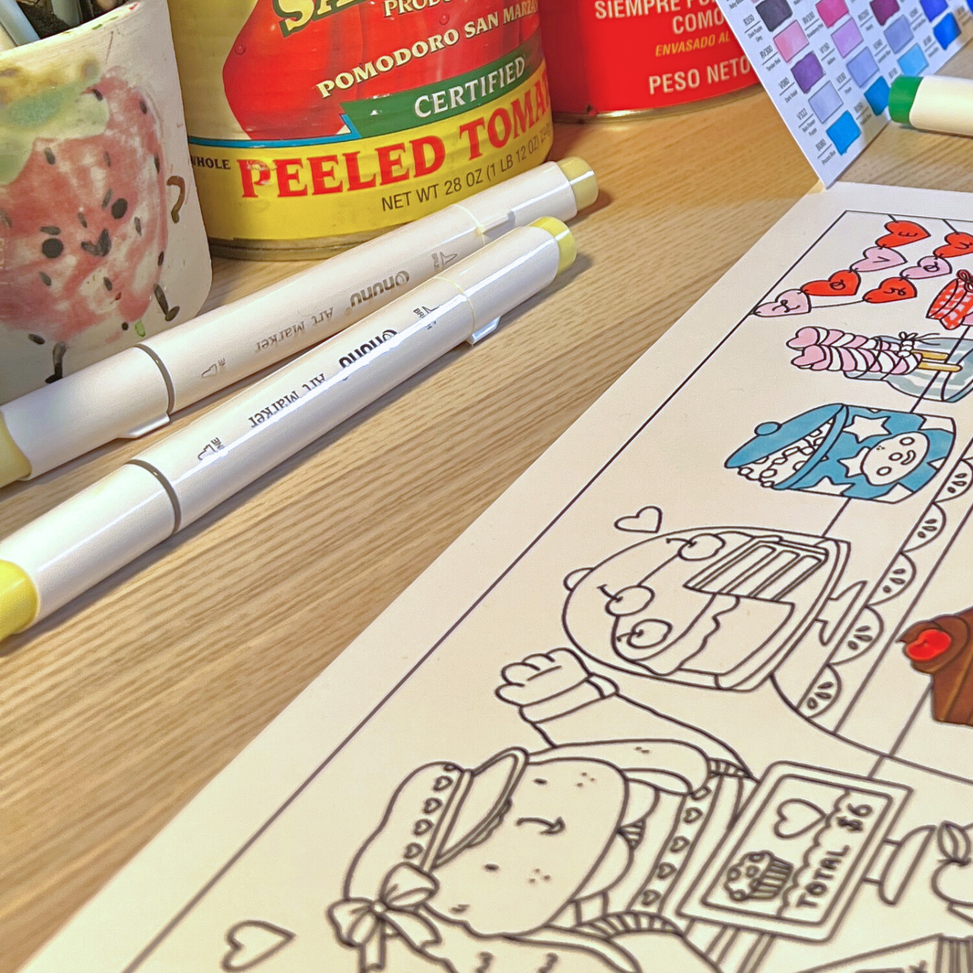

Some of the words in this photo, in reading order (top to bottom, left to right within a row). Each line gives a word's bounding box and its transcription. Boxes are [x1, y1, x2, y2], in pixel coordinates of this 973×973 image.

[316, 28, 459, 98] POMODORO
[464, 12, 500, 39] SAN
[655, 37, 716, 57] ENVASADO
[414, 55, 526, 119] CERTIFIED
[649, 69, 701, 95] PESO
[705, 54, 751, 84] NETO
[236, 135, 446, 199] PEELED
[382, 191, 411, 212] NET
[417, 183, 440, 204] WT
[443, 175, 462, 196] 28
[466, 168, 484, 187] OZ
[500, 153, 513, 173] LB
[515, 145, 527, 164] 12
[254, 320, 306, 354] Marker
[312, 306, 334, 324] Art
[248, 390, 300, 429] Marker
[795, 844, 851, 908] TOTAL
[836, 803, 873, 833] $6
